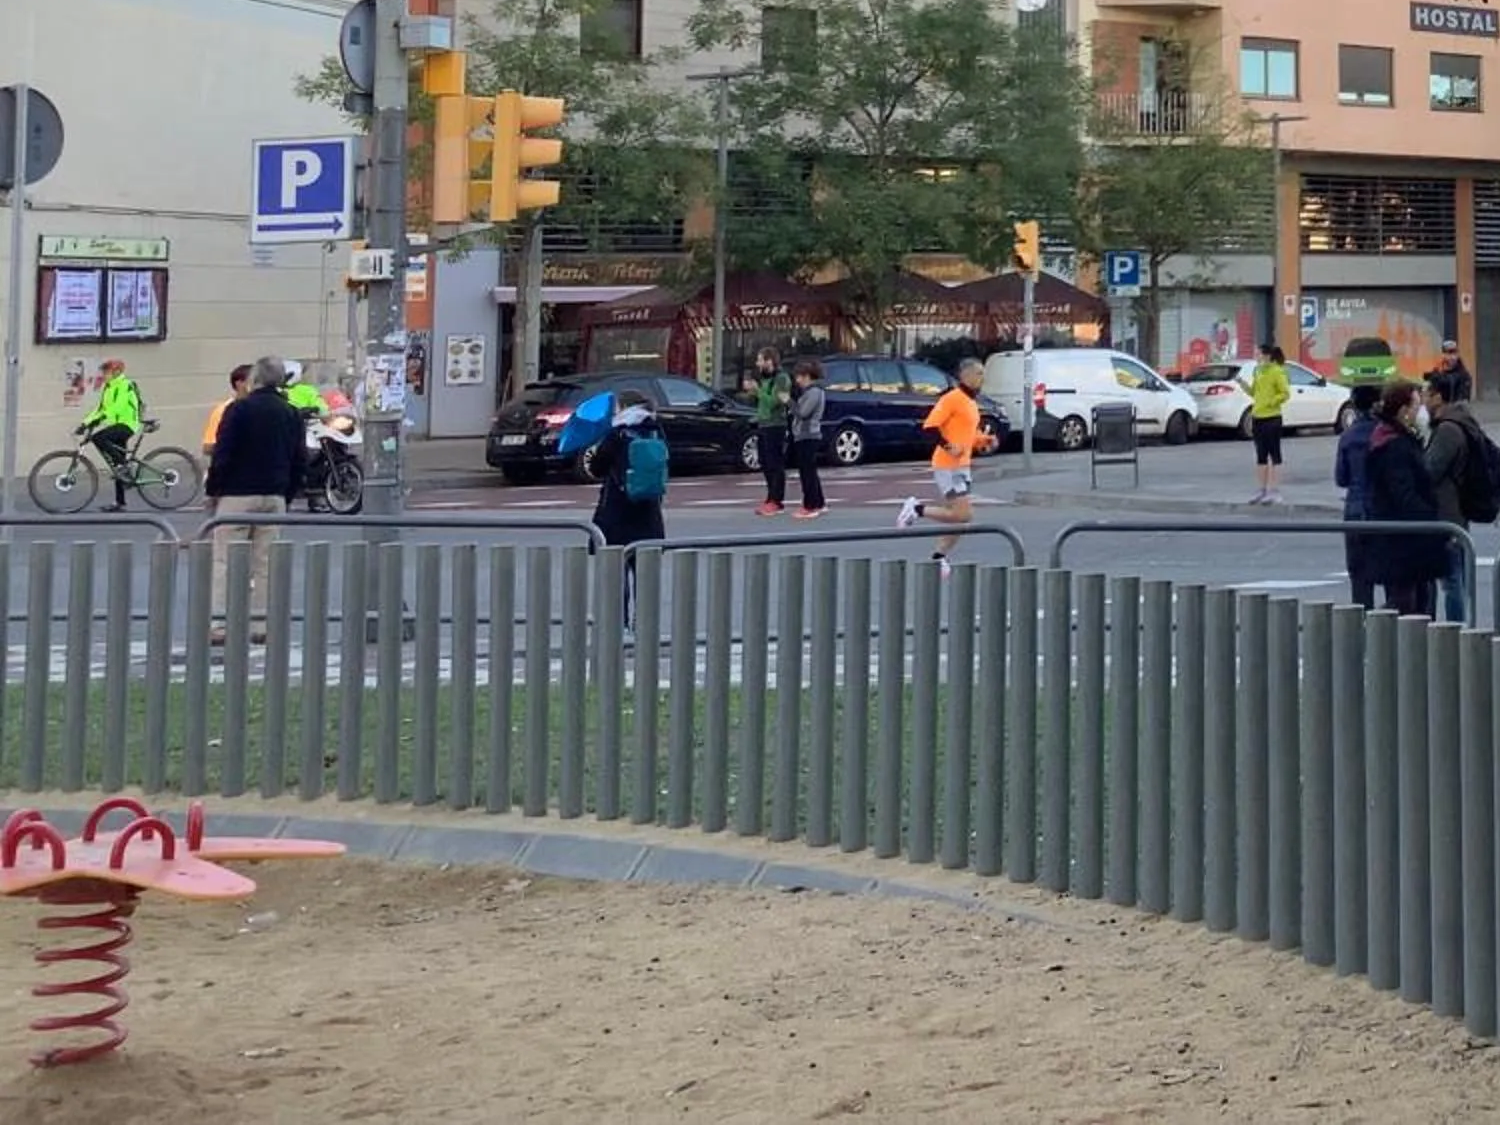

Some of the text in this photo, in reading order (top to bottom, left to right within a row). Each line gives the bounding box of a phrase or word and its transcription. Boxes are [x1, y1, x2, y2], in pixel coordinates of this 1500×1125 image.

[1414, 6, 1497, 32] HOSTAL
[281, 149, 323, 209] P
[1113, 257, 1134, 282] P
